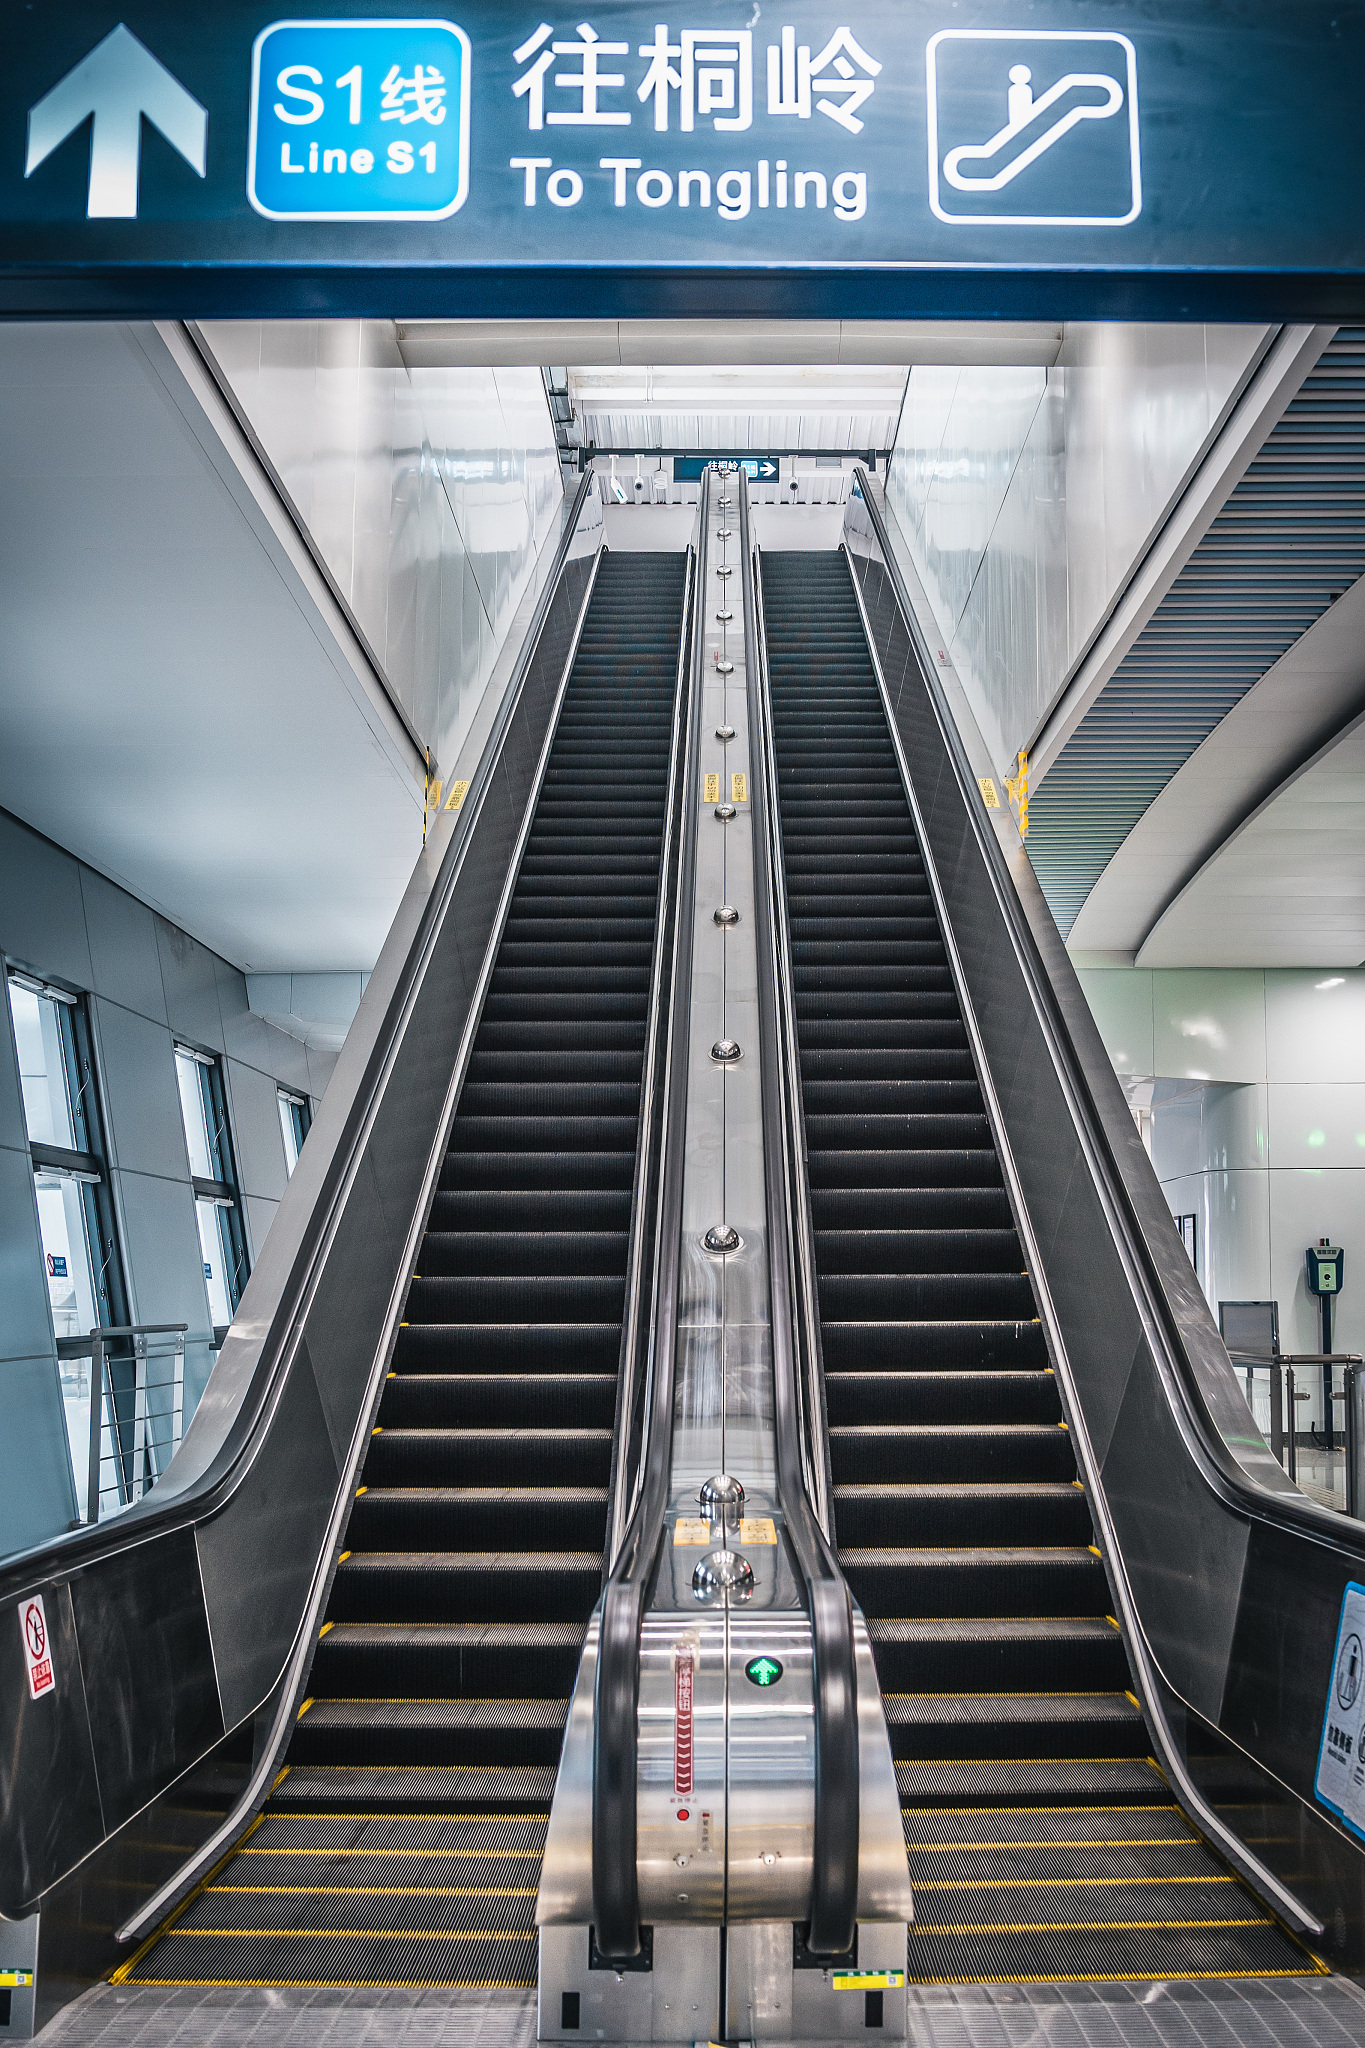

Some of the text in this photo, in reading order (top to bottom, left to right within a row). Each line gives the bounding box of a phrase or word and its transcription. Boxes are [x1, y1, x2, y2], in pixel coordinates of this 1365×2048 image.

[273, 64, 447, 126] S1线
[511, 22, 883, 134] 往桐岭
[280, 141, 438, 174] Line S1
[509, 157, 869, 221] To Tongling
[708, 460, 739, 472] 往桐岭
